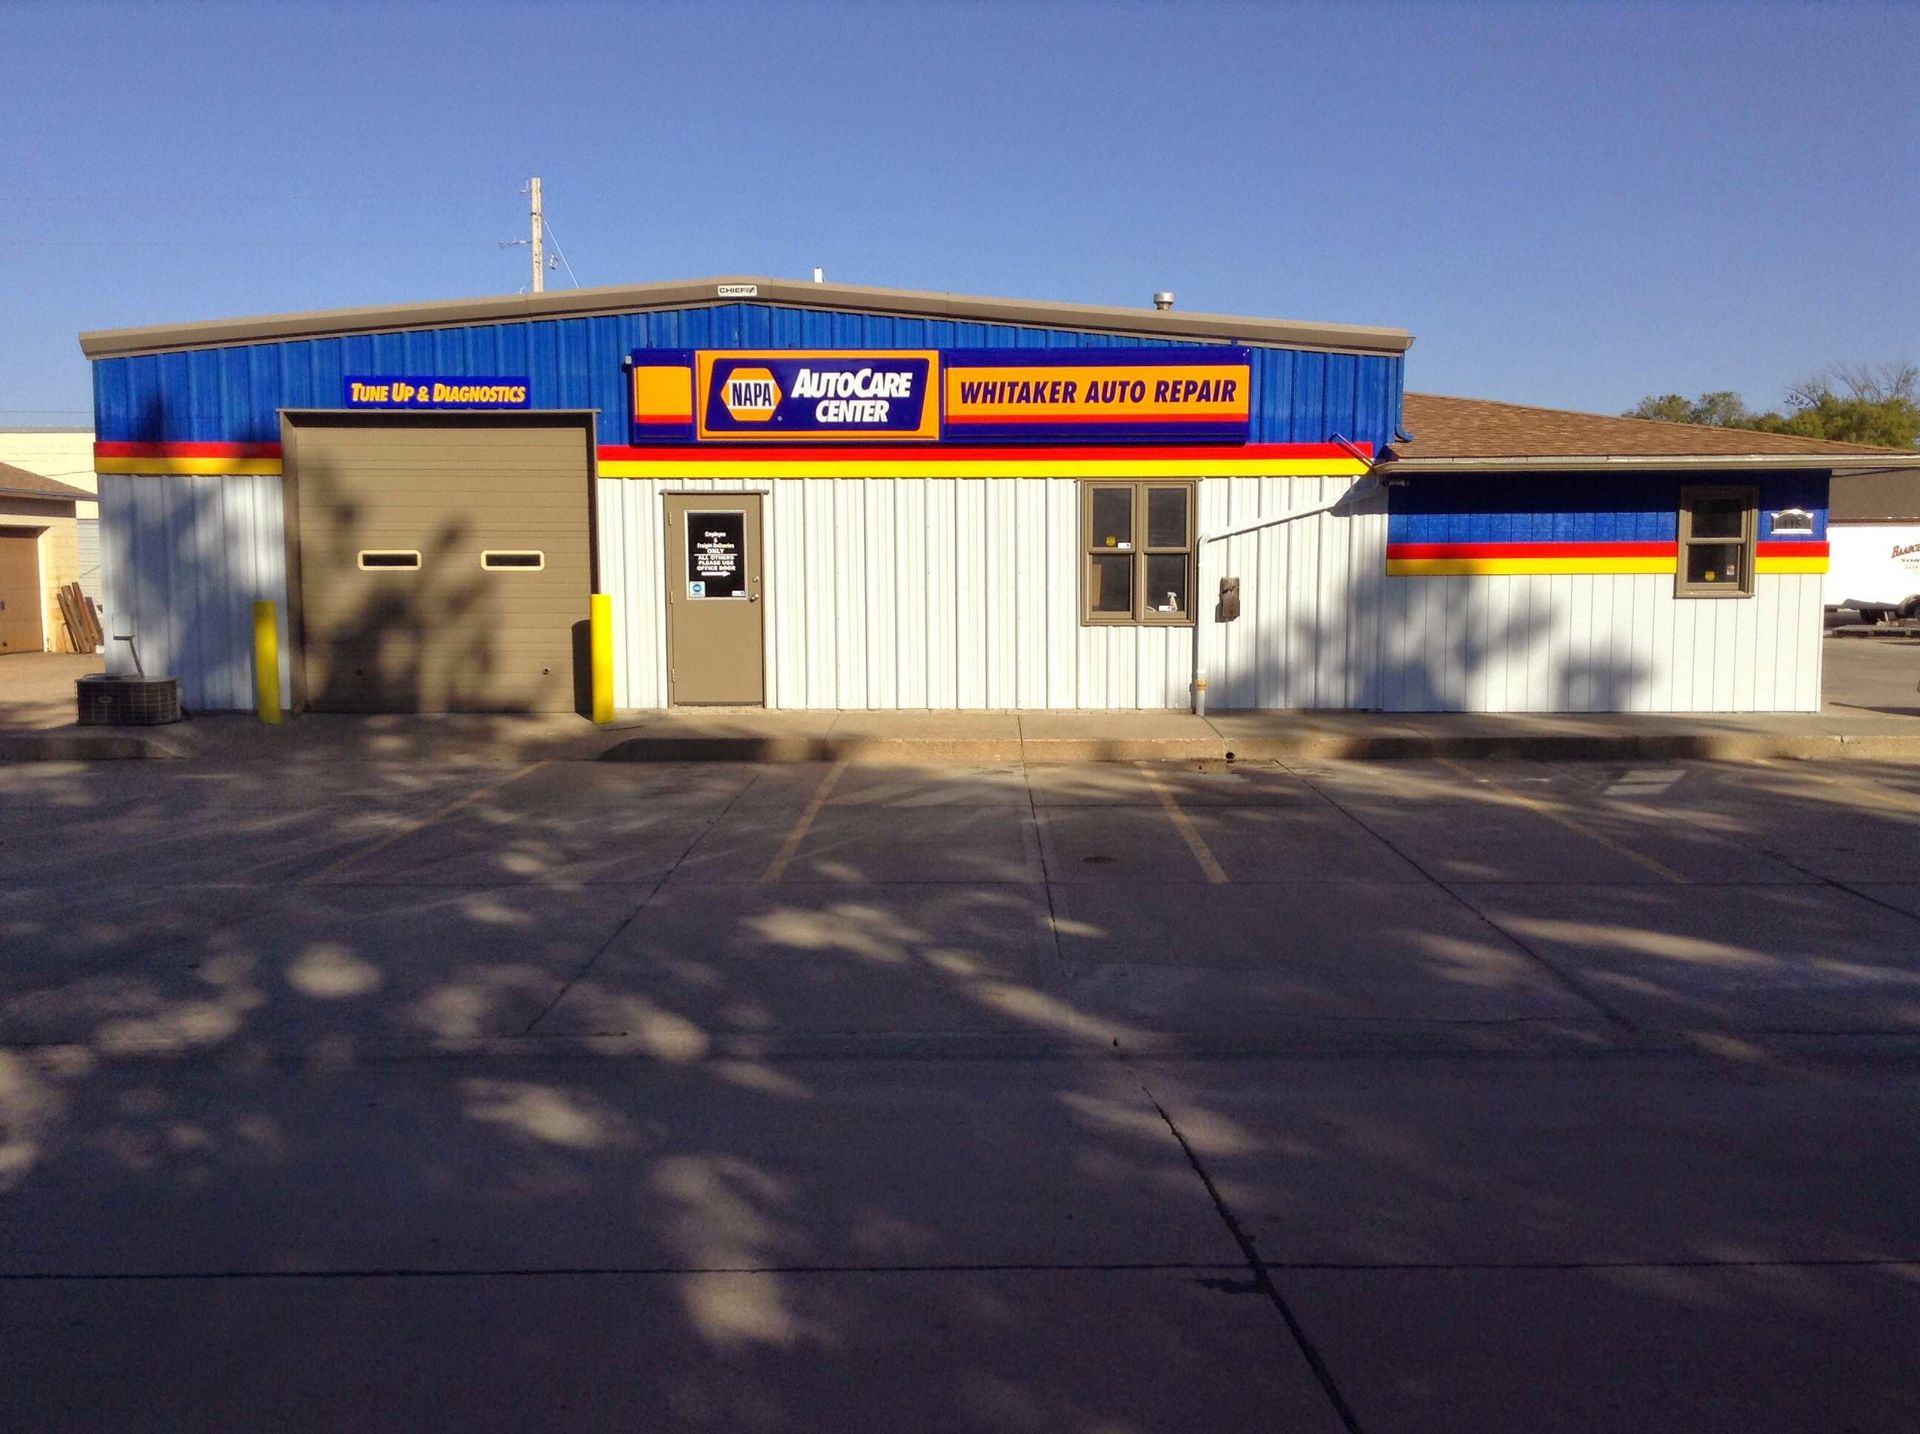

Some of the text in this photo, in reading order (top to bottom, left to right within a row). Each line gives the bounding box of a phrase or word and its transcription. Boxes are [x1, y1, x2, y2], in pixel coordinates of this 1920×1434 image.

[351, 383, 389, 402] TUNE
[417, 386, 429, 402] &
[432, 383, 526, 402] DIAGNOSTICS
[731, 382, 773, 407] NAPA
[960, 379, 1237, 404] WHITAKER AUTO REPAIR
[815, 400, 890, 423] CENTER
